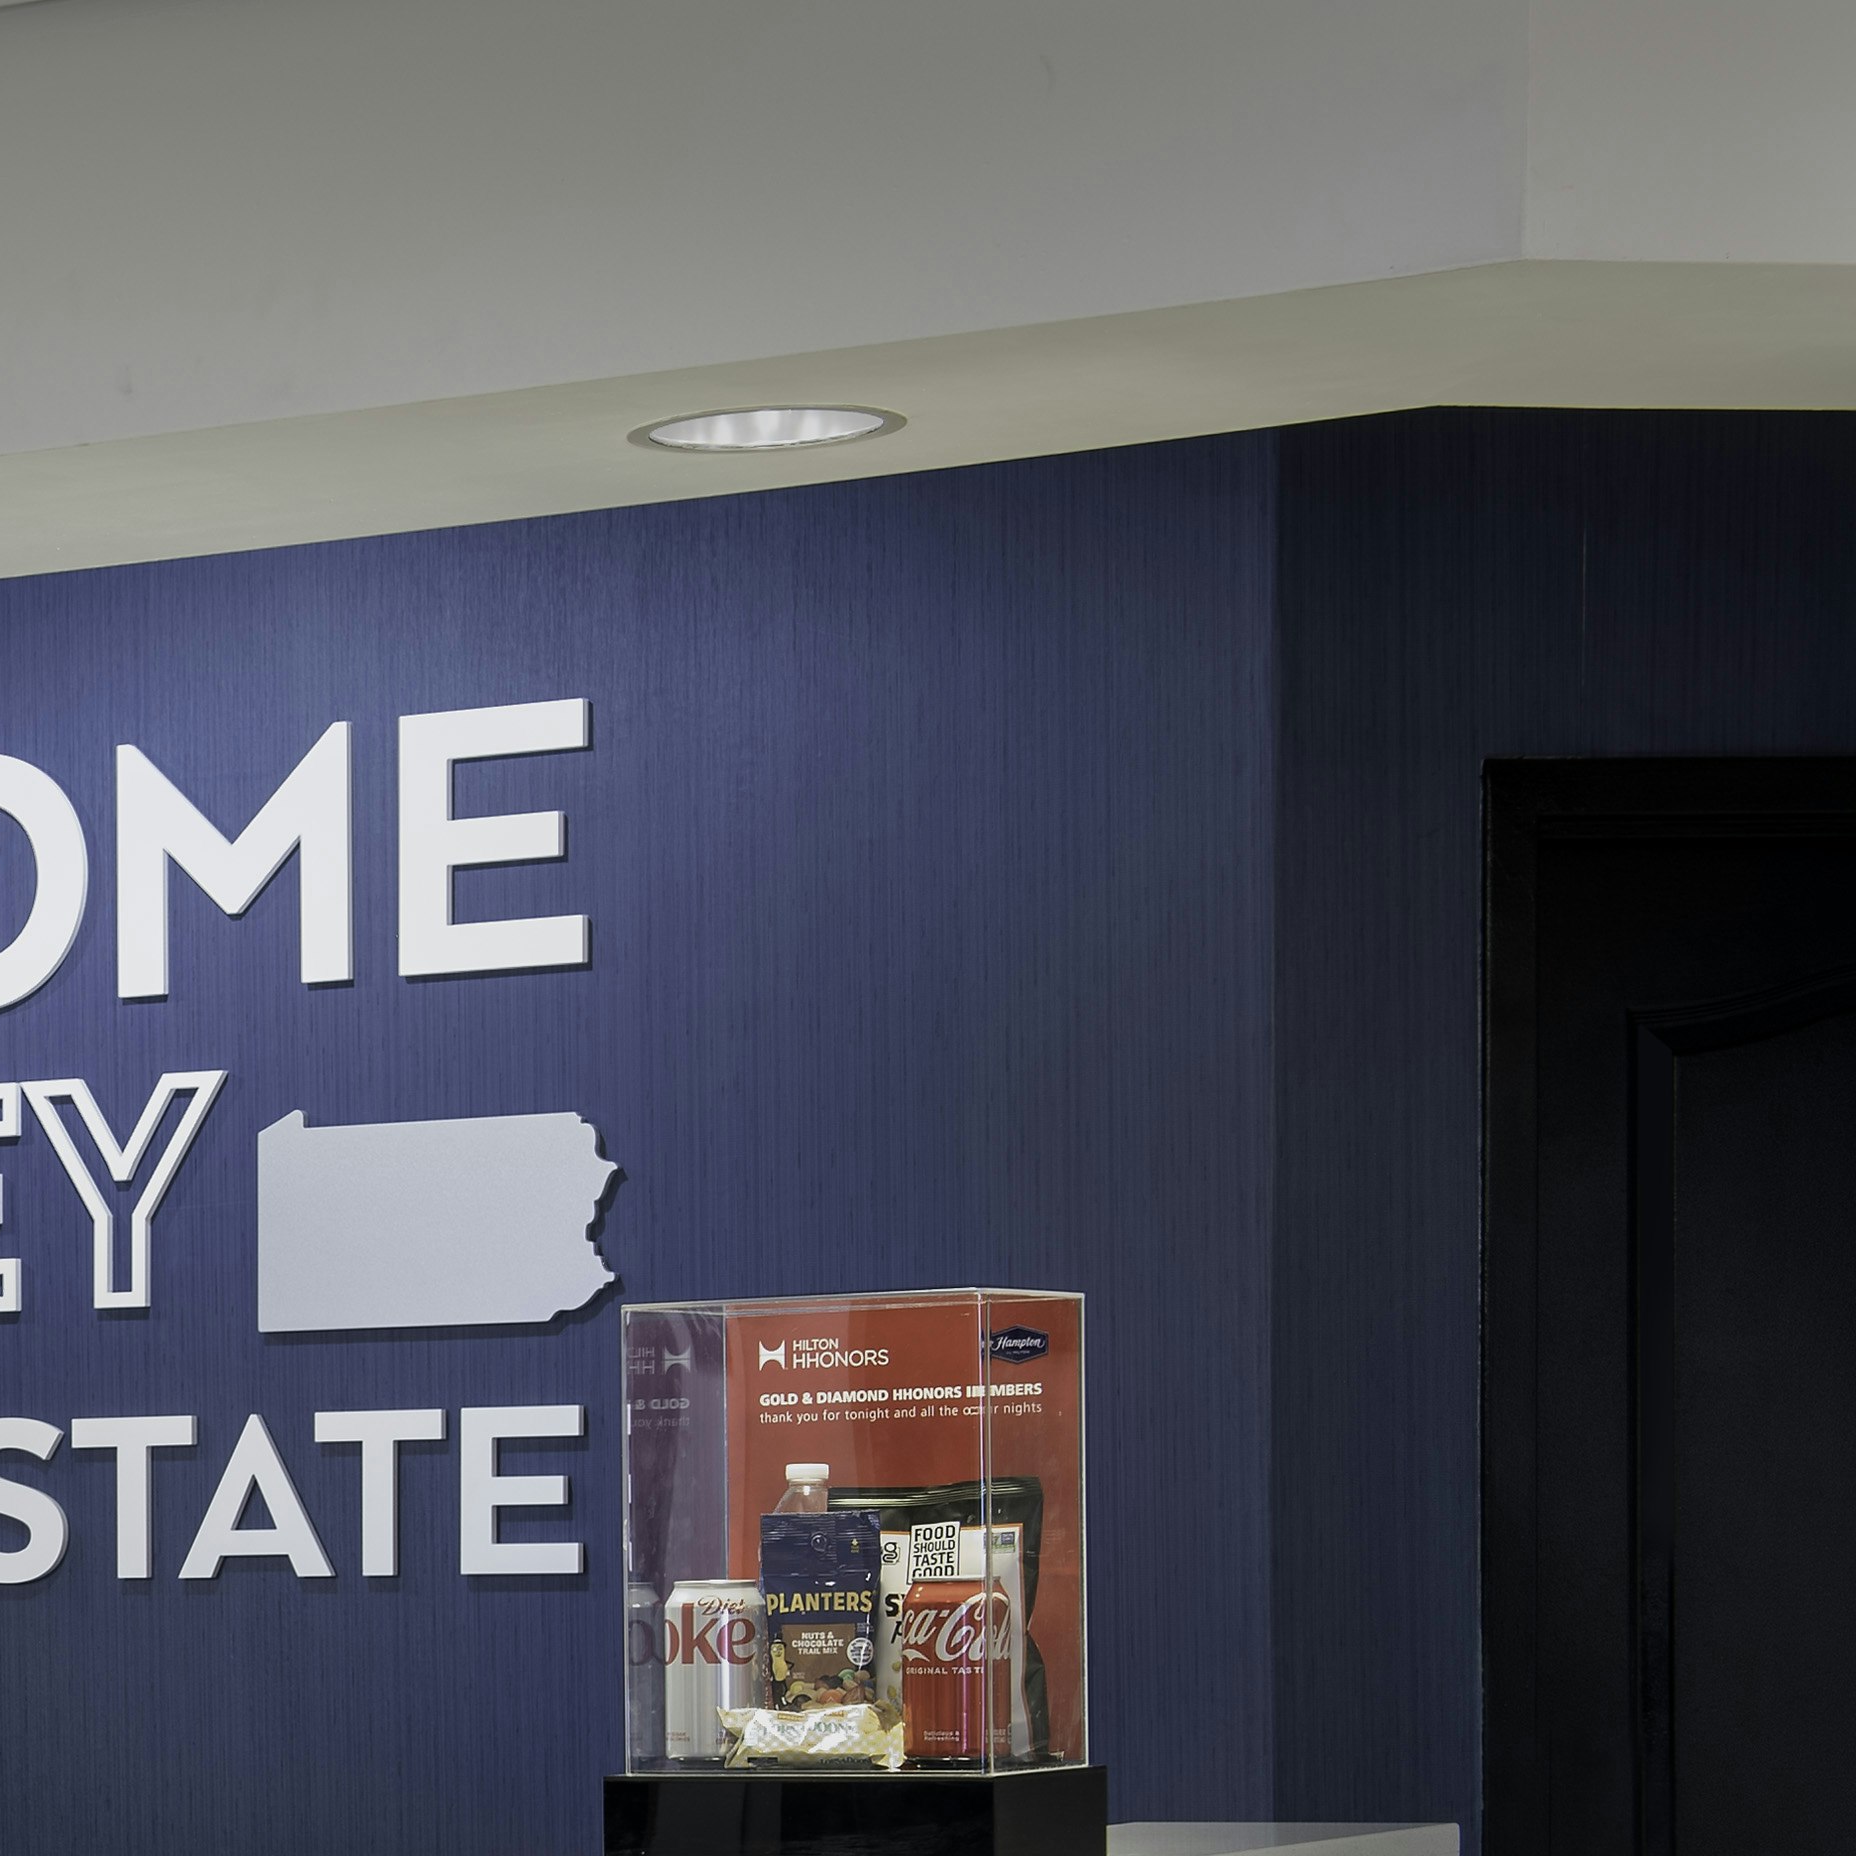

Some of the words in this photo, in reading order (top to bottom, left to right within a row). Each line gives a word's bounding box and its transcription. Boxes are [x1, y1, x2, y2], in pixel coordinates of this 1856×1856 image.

[792, 1338, 839, 1351] HILTON
[992, 1336, 1045, 1351] Hampton
[792, 1349, 889, 1369] HHONORS
[759, 1393, 799, 1406] GOLD
[802, 1392, 813, 1405] &
[816, 1389, 889, 1404] DIAMOND
[892, 1386, 962, 1401] HHONORS
[760, 1411, 793, 1424] thank
[796, 1412, 818, 1425] you
[822, 1409, 840, 1421] for
[844, 1407, 889, 1422] tonight
[893, 1405, 916, 1418] and
[920, 1405, 934, 1417] all
[939, 1404, 958, 1416] the
[1003, 1401, 1042, 1416] nights
[914, 1525, 956, 1542] FOOD
[913, 1539, 956, 1554] SHOULD
[913, 1551, 955, 1567] TASTE
[766, 1590, 873, 1617] PLANTERS
[664, 1602, 756, 1665] oke
[802, 1632, 826, 1640] NUTS
[792, 1639, 844, 1648] CHOCOLATE
[798, 1647, 821, 1655] TRAIL
[823, 1647, 838, 1655] MIX
[906, 1666, 948, 1675] ORIGINAL
